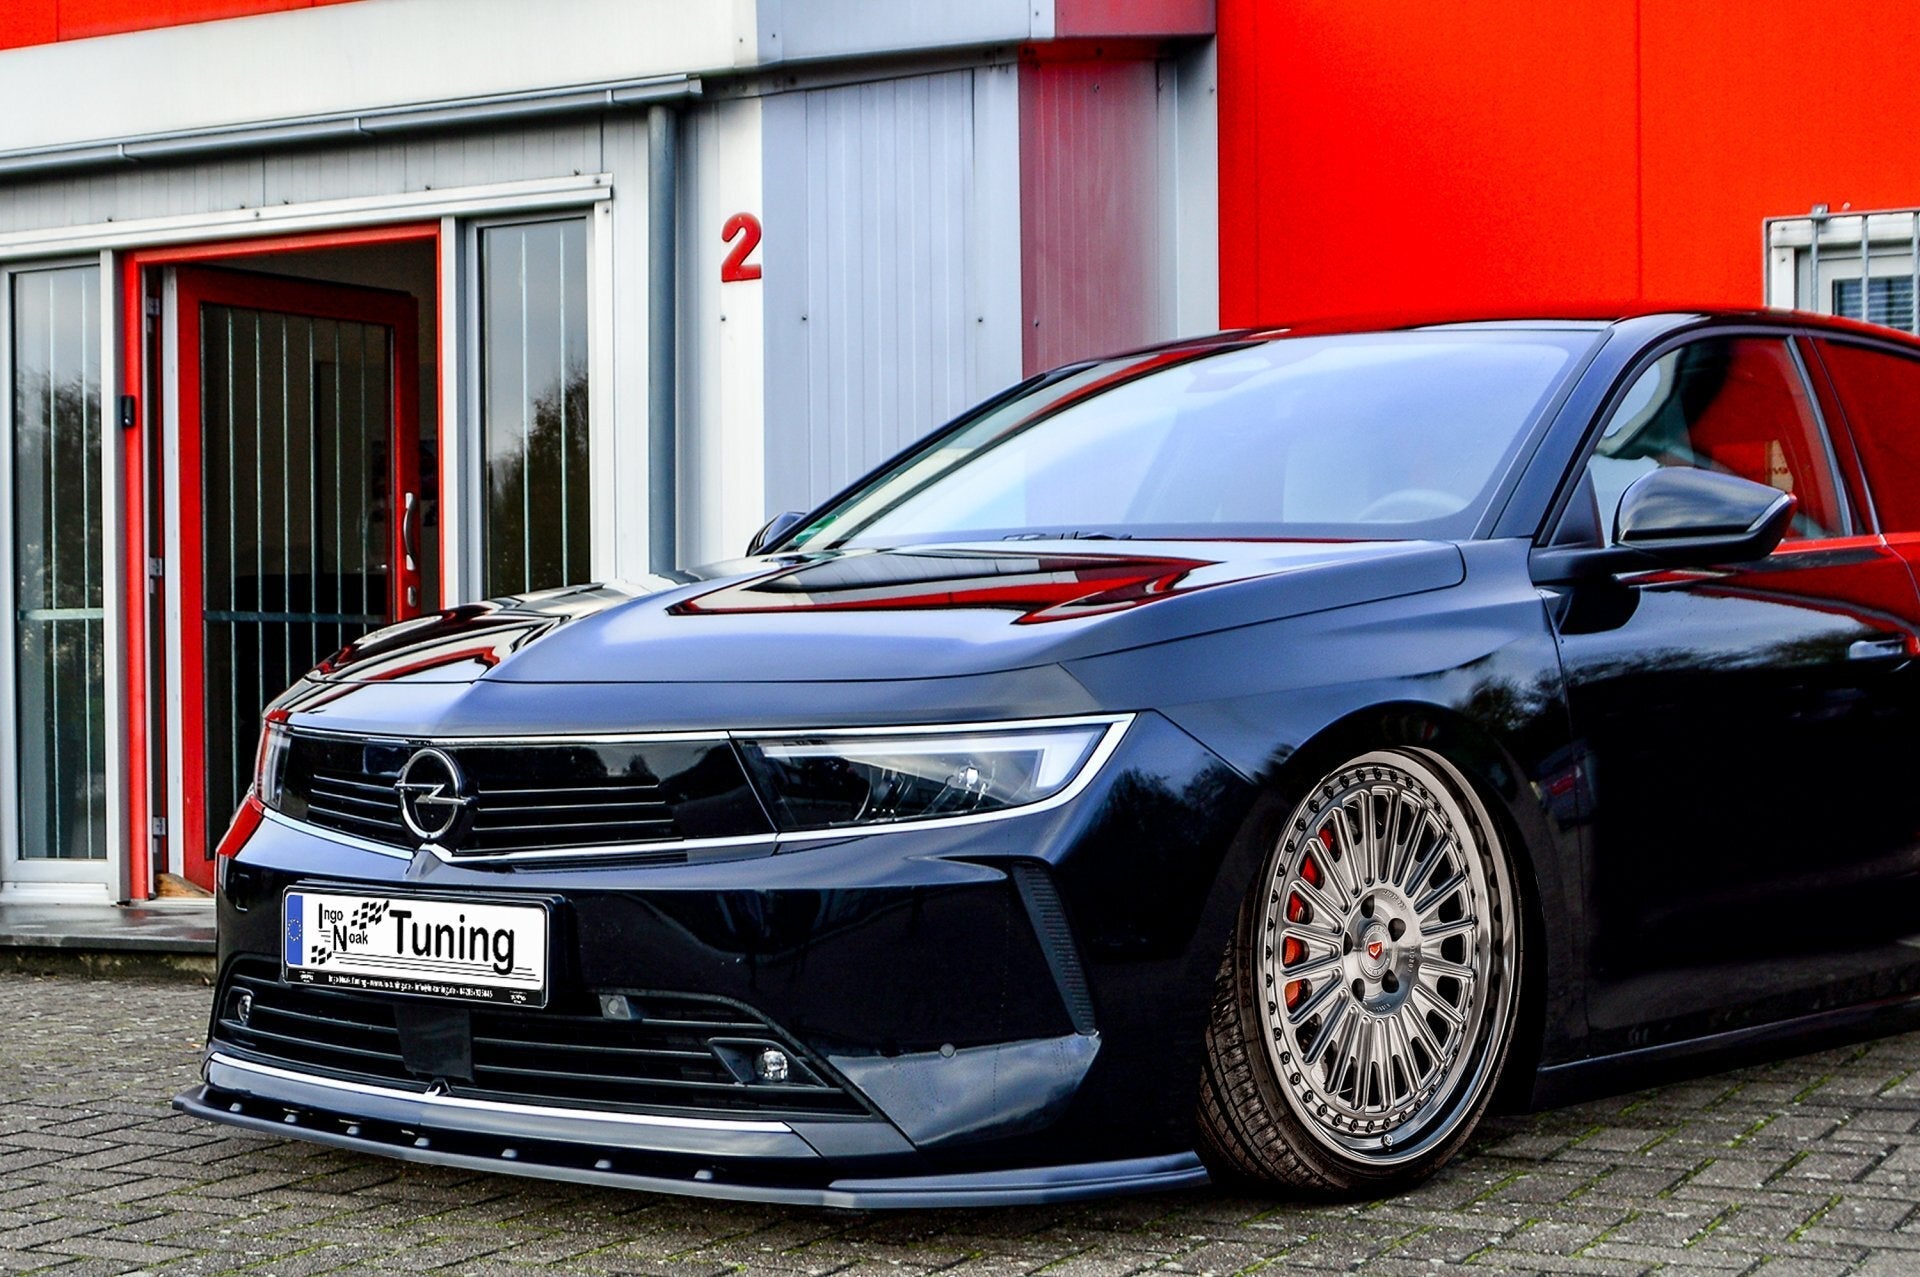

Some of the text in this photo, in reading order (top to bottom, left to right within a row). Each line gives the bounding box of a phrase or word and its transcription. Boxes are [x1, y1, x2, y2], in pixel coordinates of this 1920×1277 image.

[721, 212, 761, 282] 2
[318, 903, 344, 929] Ingo
[333, 924, 369, 952] Noak
[389, 909, 515, 975] Tuning
